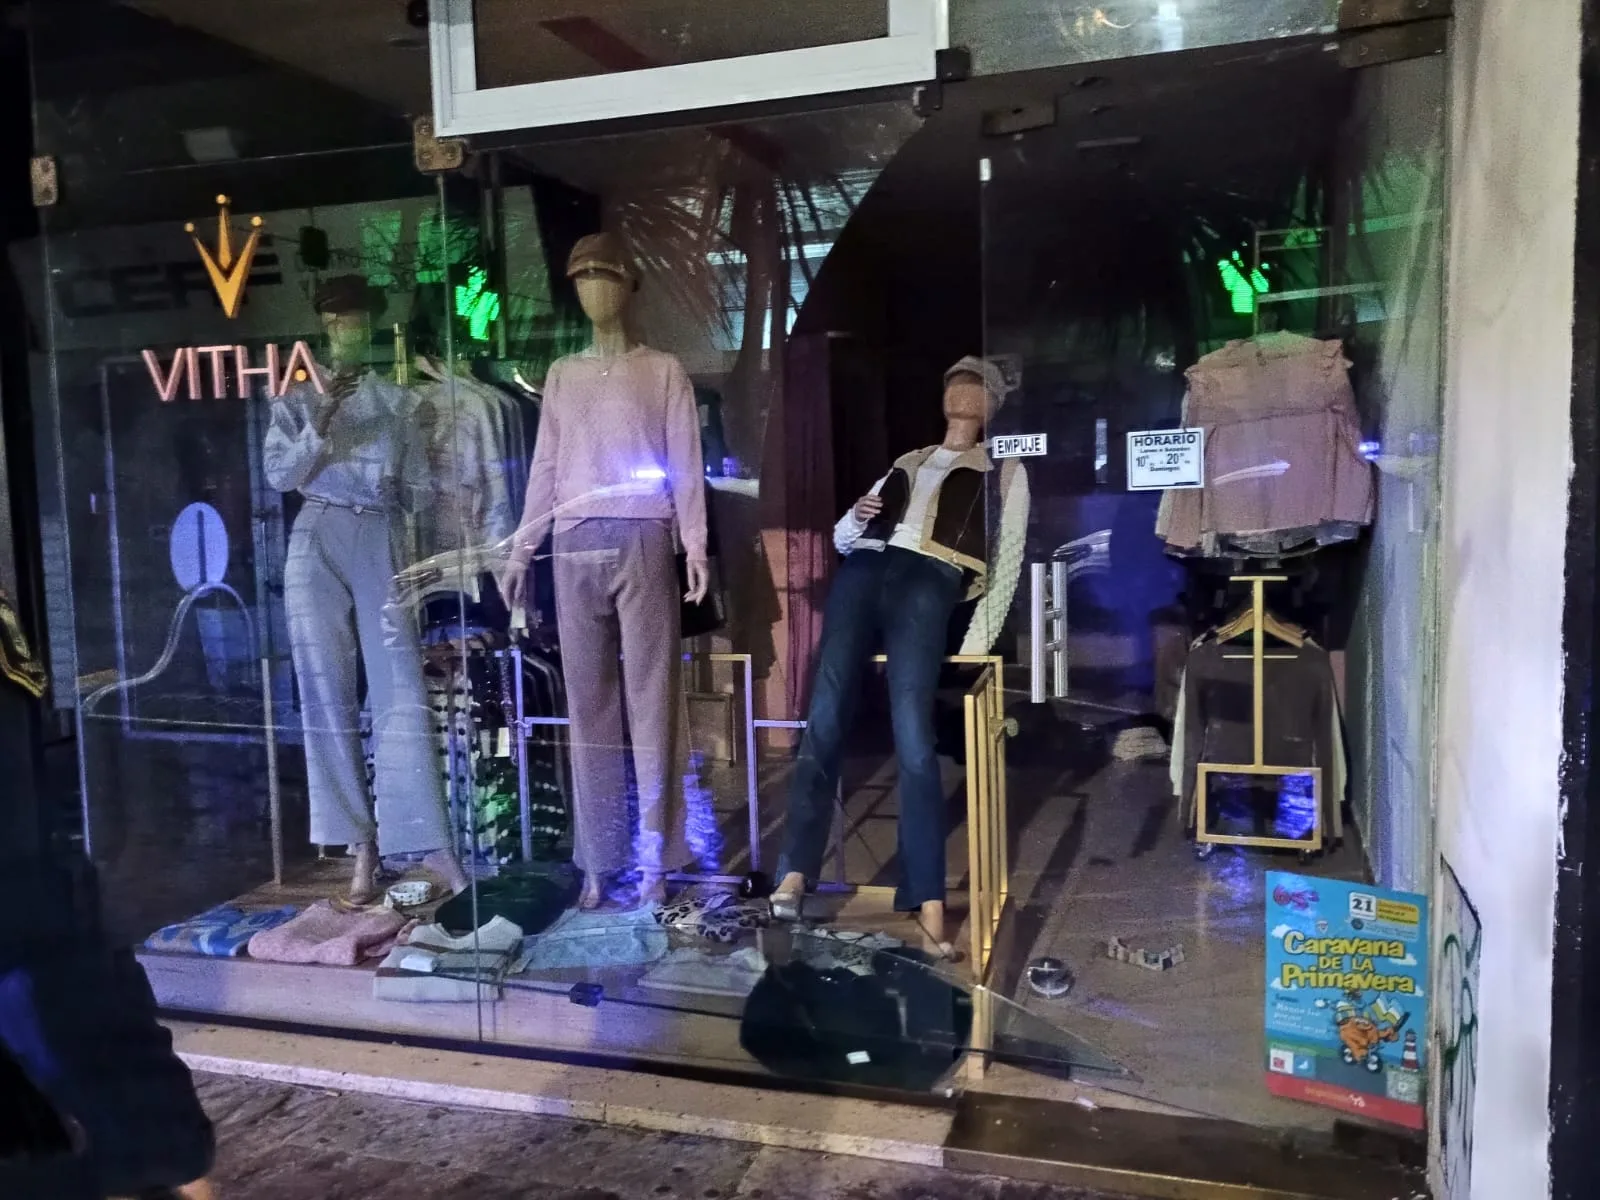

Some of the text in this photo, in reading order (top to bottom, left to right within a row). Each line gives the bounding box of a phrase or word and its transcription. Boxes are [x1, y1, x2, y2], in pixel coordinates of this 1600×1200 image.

[142, 341, 325, 402] VITHA
[997, 436, 1042, 454] EMPUJE
[1134, 434, 1197, 447] HORARIO
[1352, 898, 1374, 913] 21
[1283, 931, 1405, 959] Caravana
[1319, 956, 1375, 972] DE LA
[1280, 963, 1416, 994] Primavera
